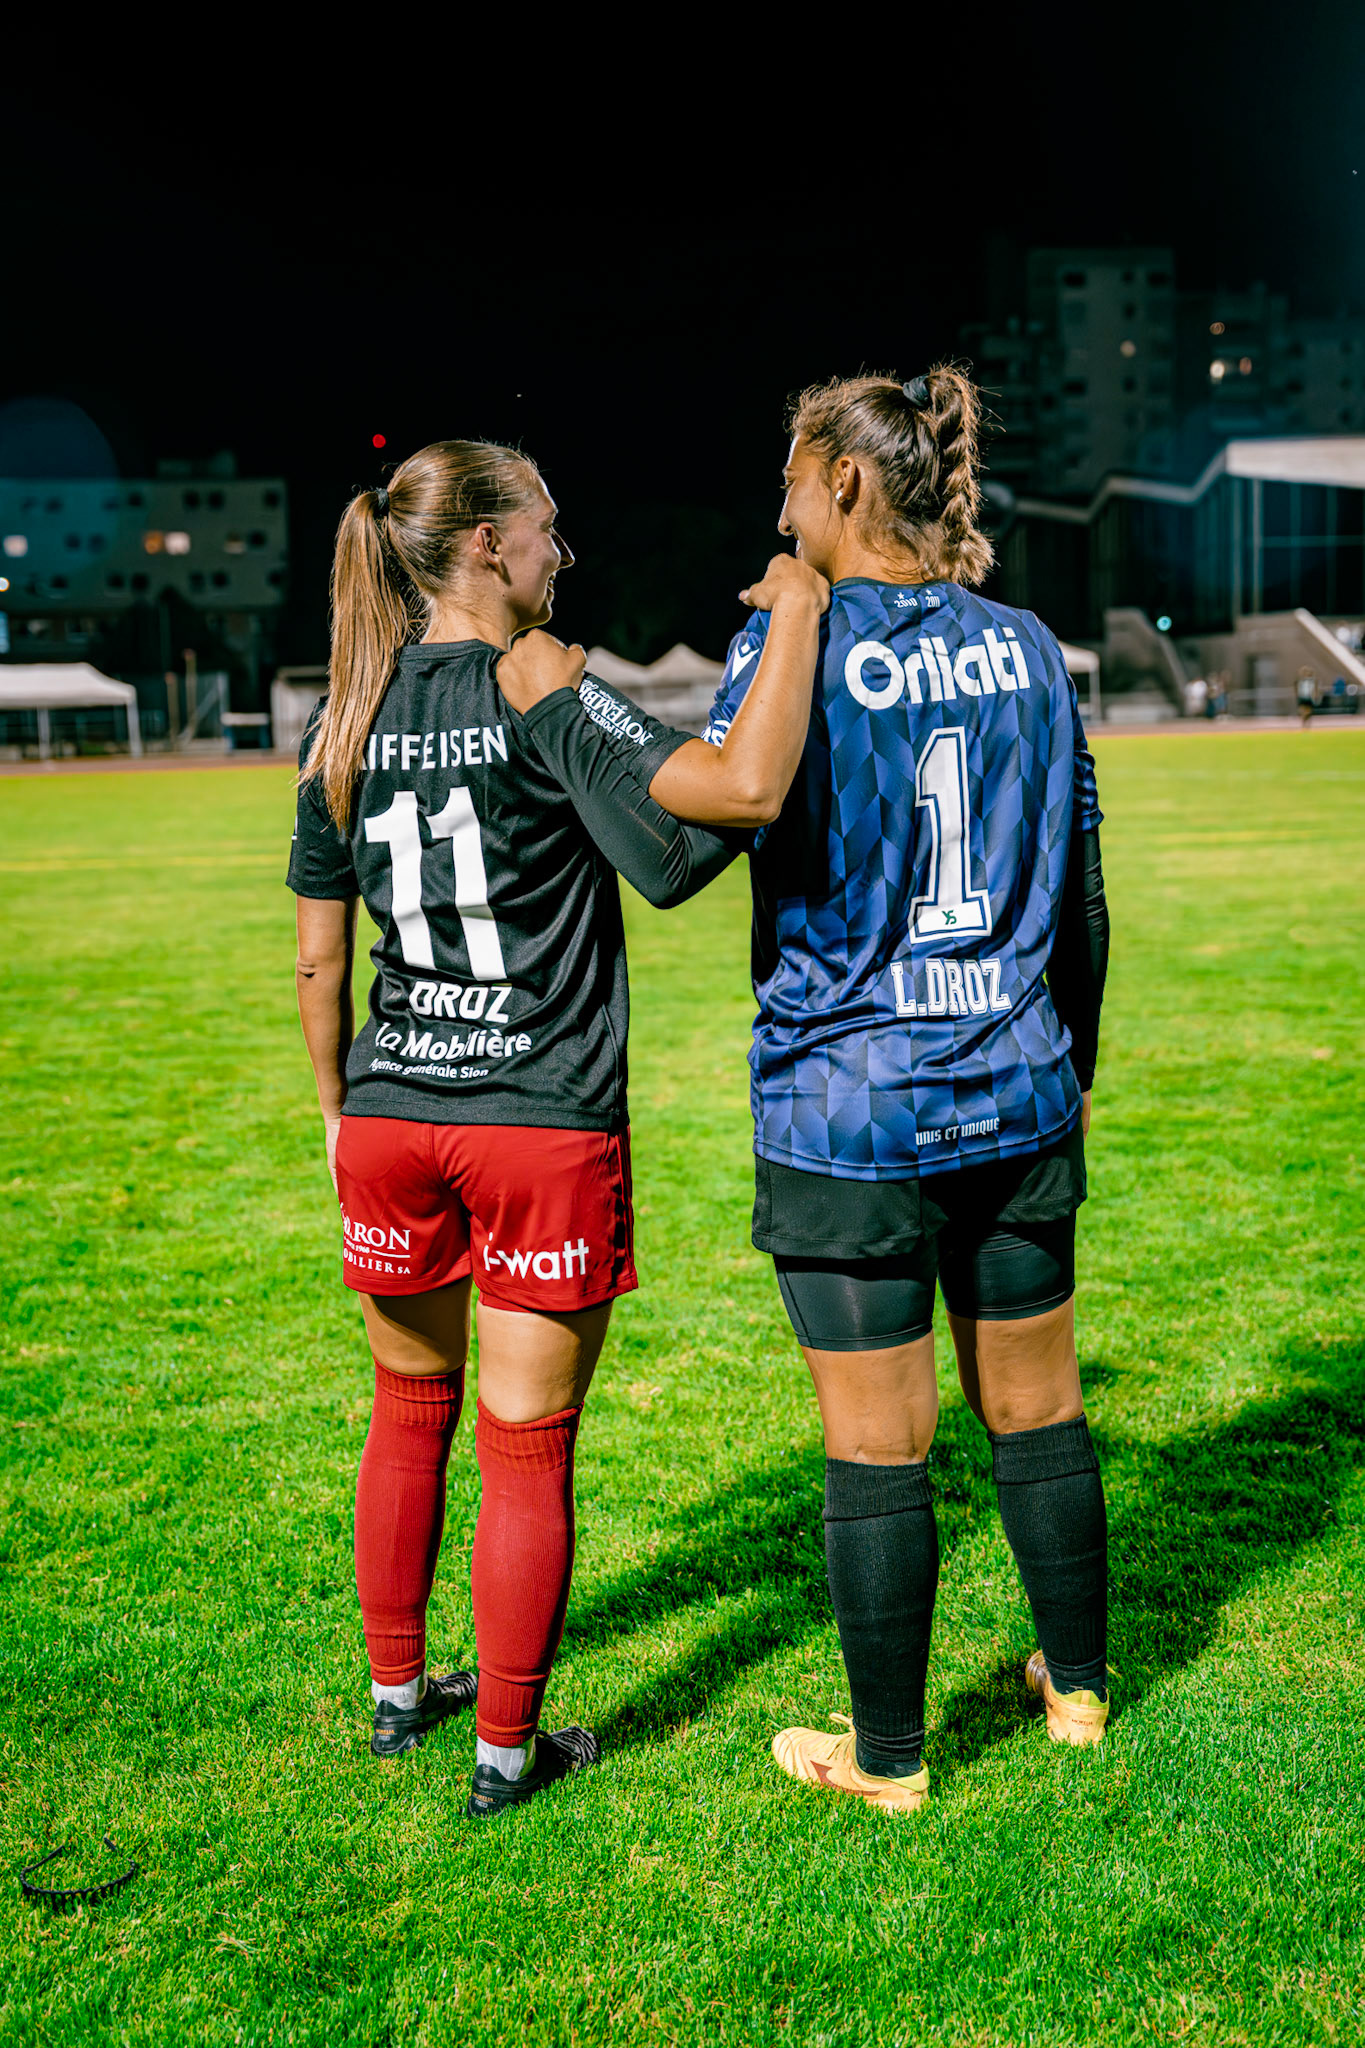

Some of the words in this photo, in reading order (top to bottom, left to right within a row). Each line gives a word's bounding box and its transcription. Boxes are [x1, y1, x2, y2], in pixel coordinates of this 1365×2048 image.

[893, 597, 918, 608] 2010
[844, 626, 1031, 710] Orllati
[362, 724, 509, 771] IFFEISEN
[907, 725, 993, 944] 1
[364, 785, 508, 982] 11
[408, 980, 513, 1024] DROZ
[890, 958, 1013, 1018] L.DROZ
[368, 1057, 403, 1073] Agence
[402, 1062, 458, 1079] générale
[459, 1065, 489, 1080] Sion
[960, 1116, 1000, 1138] UNIQUE
[343, 1247, 395, 1274] OBILIER
[397, 1265, 412, 1275] SA
[483, 1231, 589, 1280] i-watt
